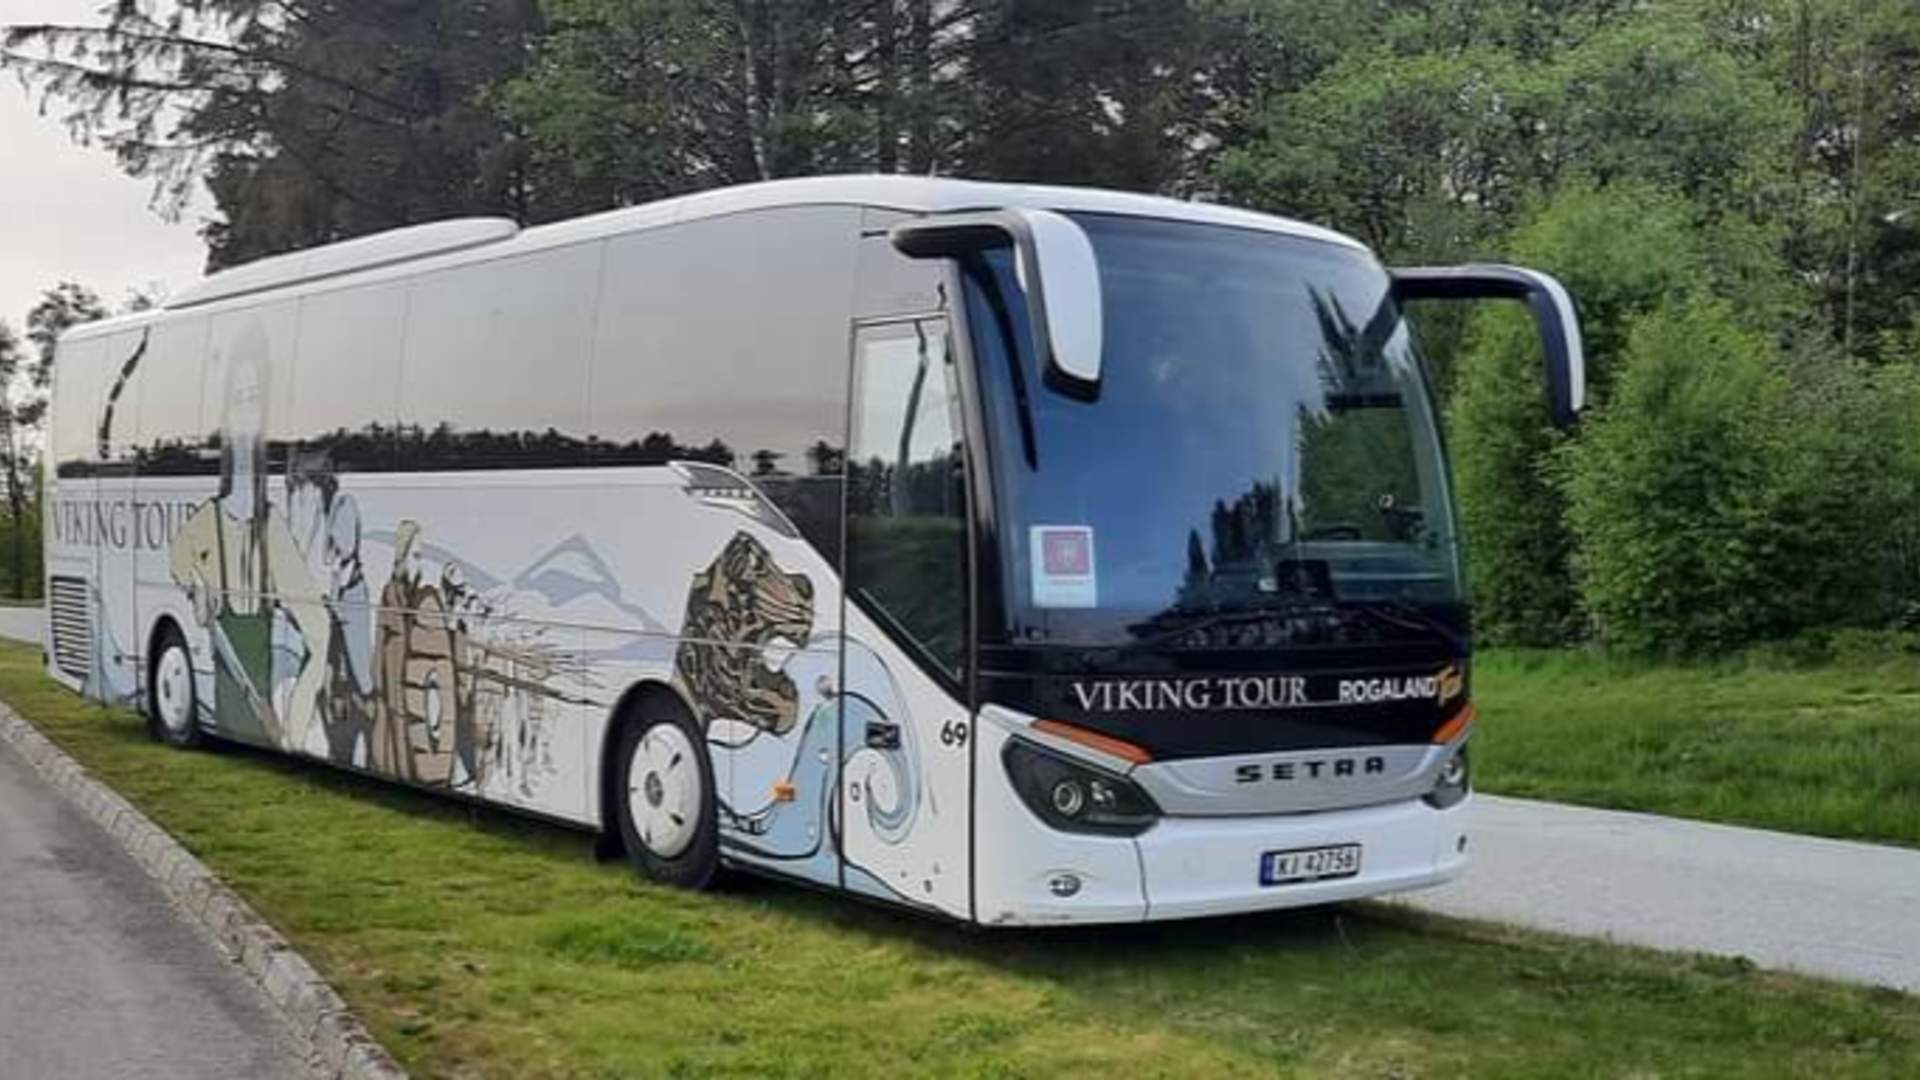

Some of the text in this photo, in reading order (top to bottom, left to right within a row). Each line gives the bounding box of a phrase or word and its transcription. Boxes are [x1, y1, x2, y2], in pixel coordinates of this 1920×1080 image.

[51, 501, 126, 549] VIKING
[1073, 677, 1307, 712] VIKING TOUR
[1339, 676, 1436, 701] ROGALAND
[940, 720, 967, 747] 69
[1235, 756, 1385, 783] SETRA
